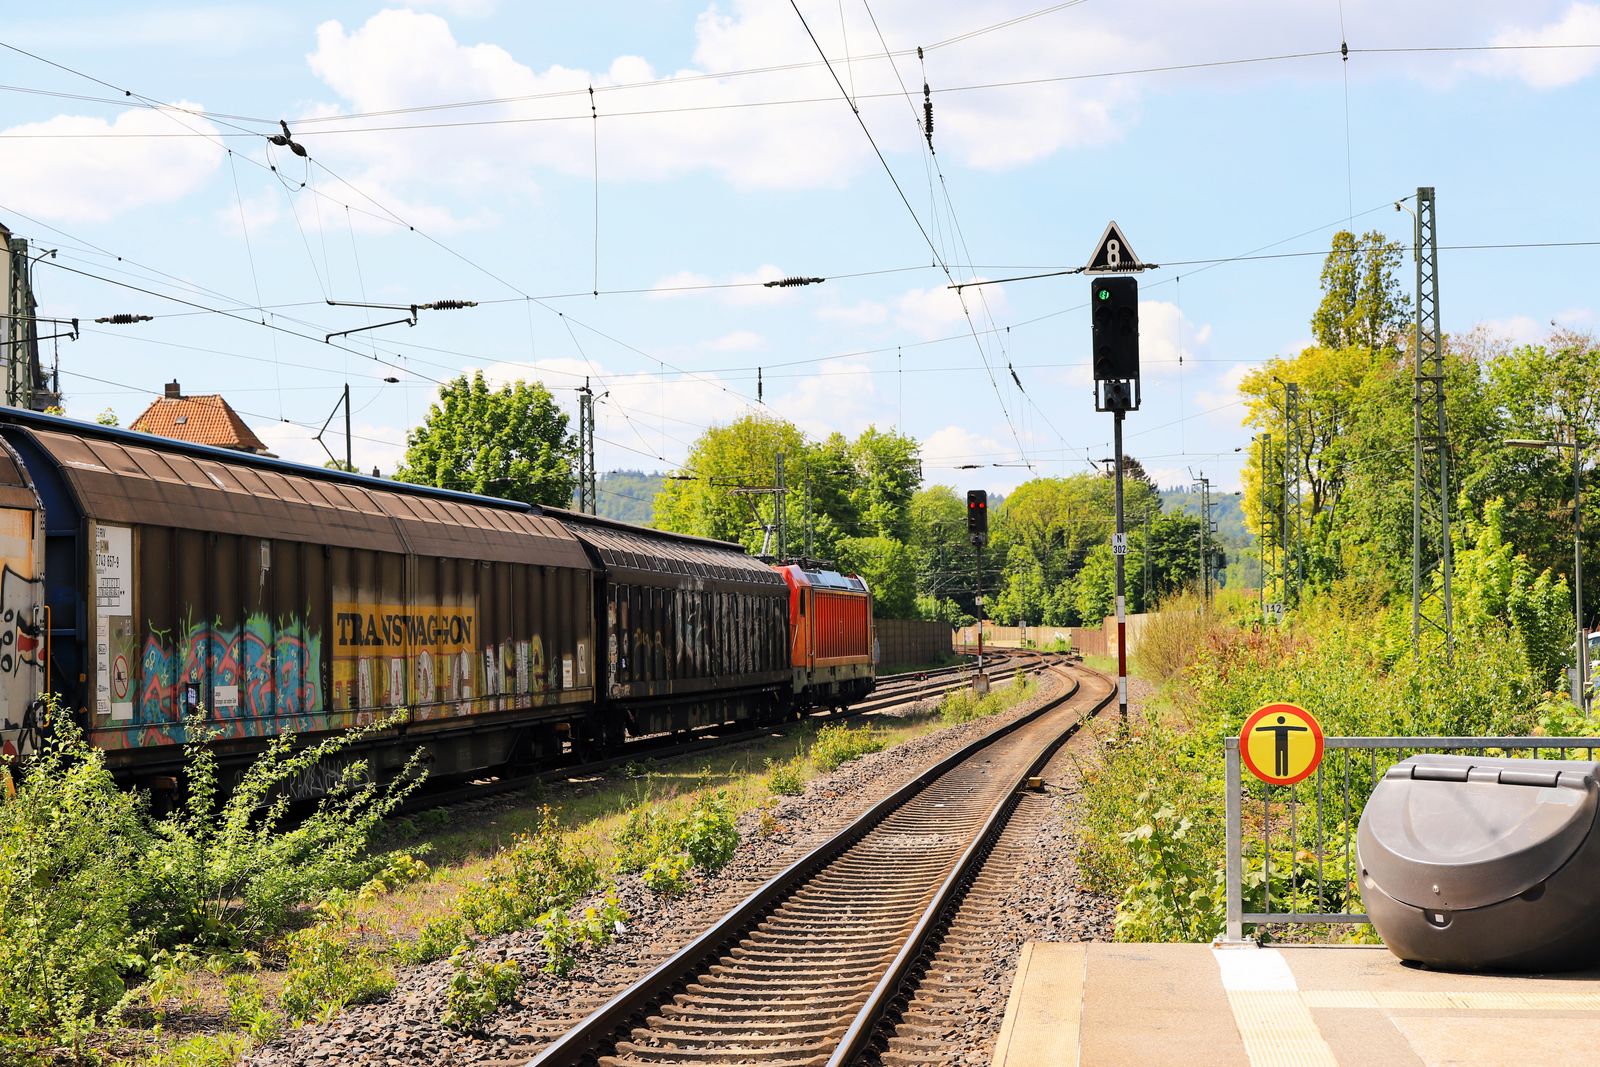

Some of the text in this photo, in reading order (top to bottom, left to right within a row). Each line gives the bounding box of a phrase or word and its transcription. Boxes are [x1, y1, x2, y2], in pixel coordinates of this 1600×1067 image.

[1106, 239, 1120, 266] 8
[1116, 535, 1122, 543] N
[1113, 545, 1127, 554] 302
[337, 612, 473, 646] TRANSWAGGON
